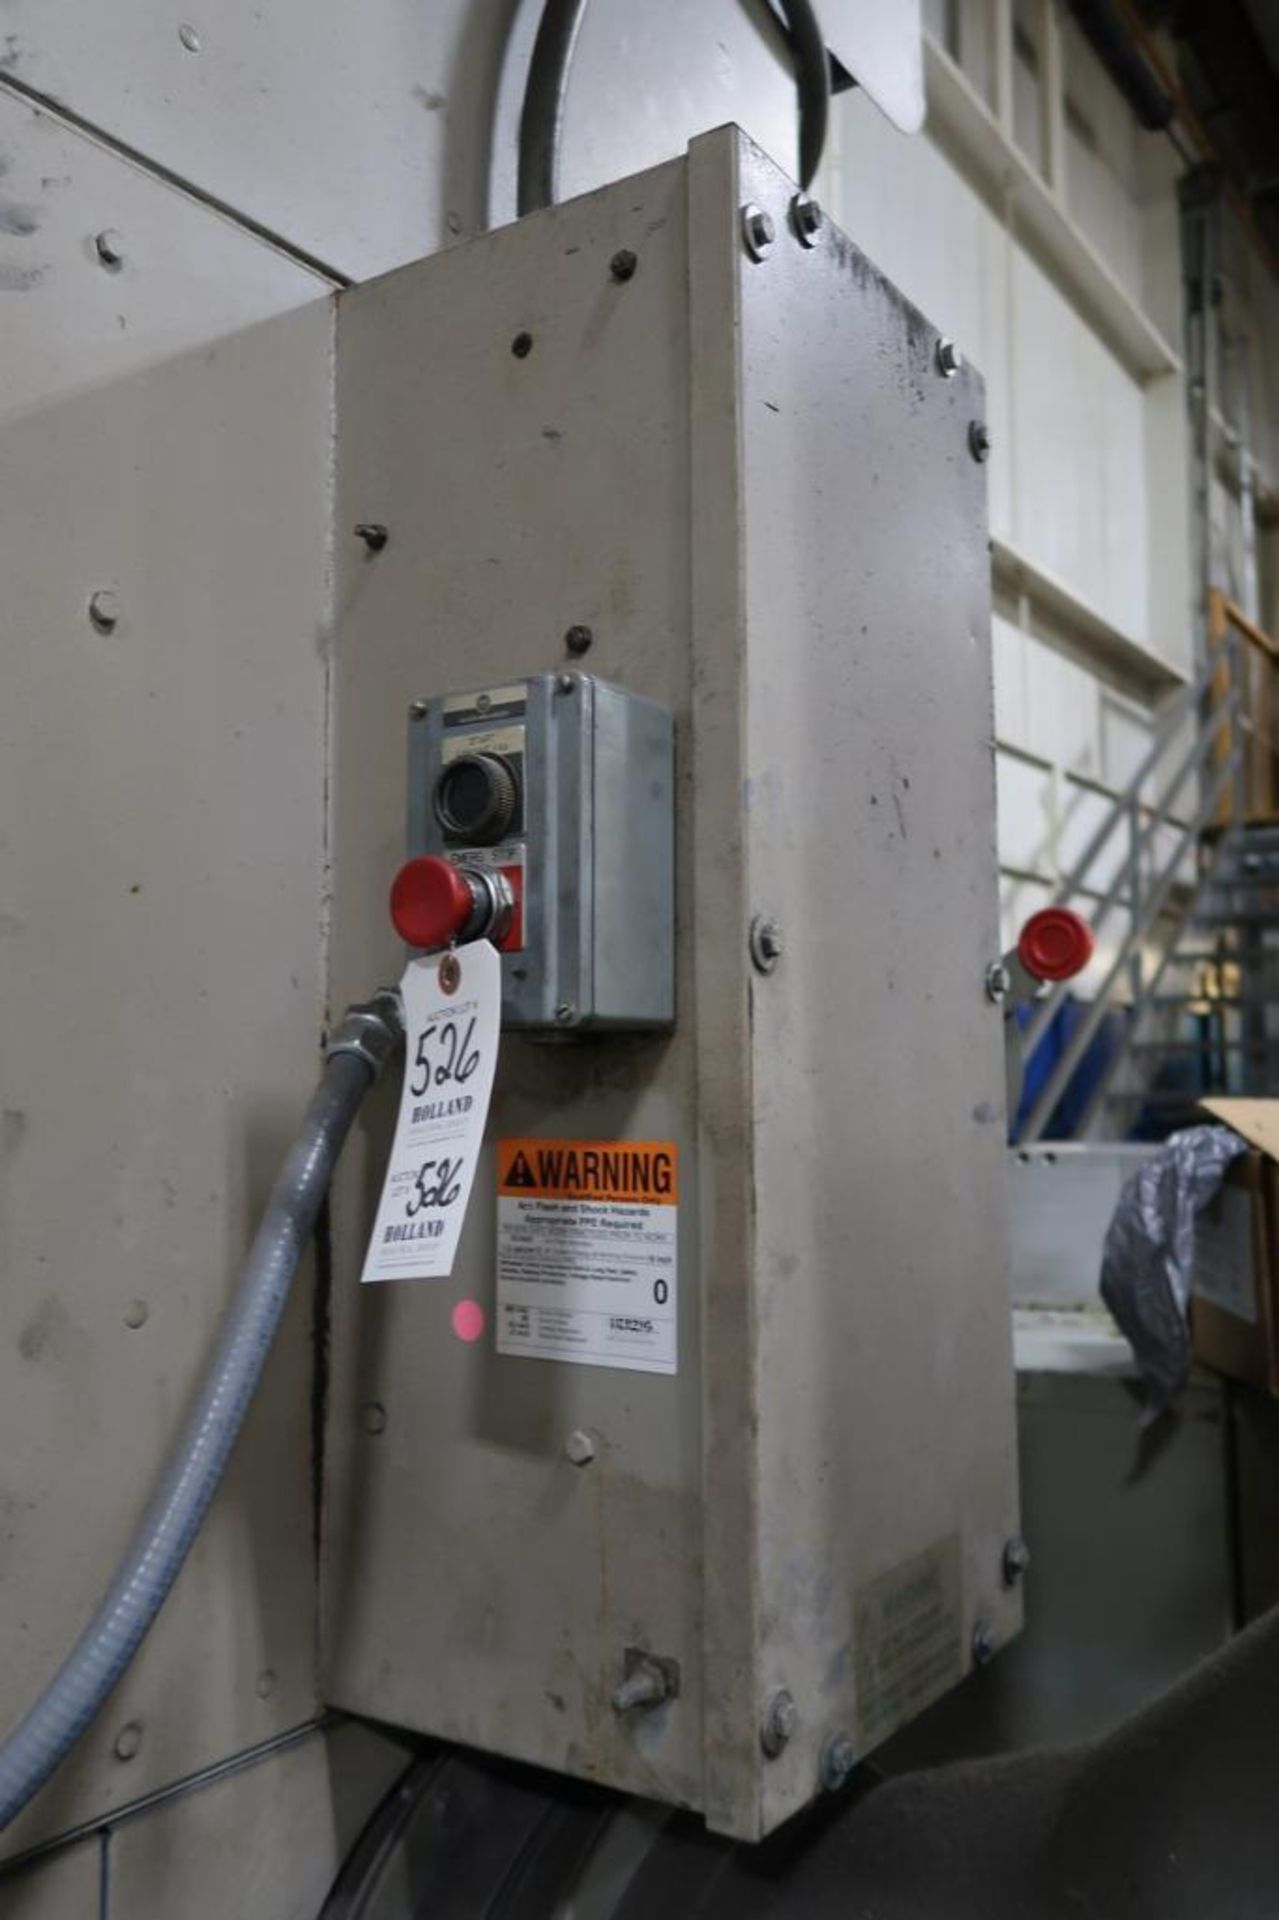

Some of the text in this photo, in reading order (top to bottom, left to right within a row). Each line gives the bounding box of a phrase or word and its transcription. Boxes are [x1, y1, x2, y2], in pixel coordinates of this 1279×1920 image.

[411, 1016, 480, 1097] 526
[412, 1095, 473, 1124] HOLLAND
[406, 1158, 464, 1218] 526
[537, 1149, 672, 1194] WARNING
[383, 1220, 444, 1243] HOLLAND
[653, 1278, 669, 1305] 0
